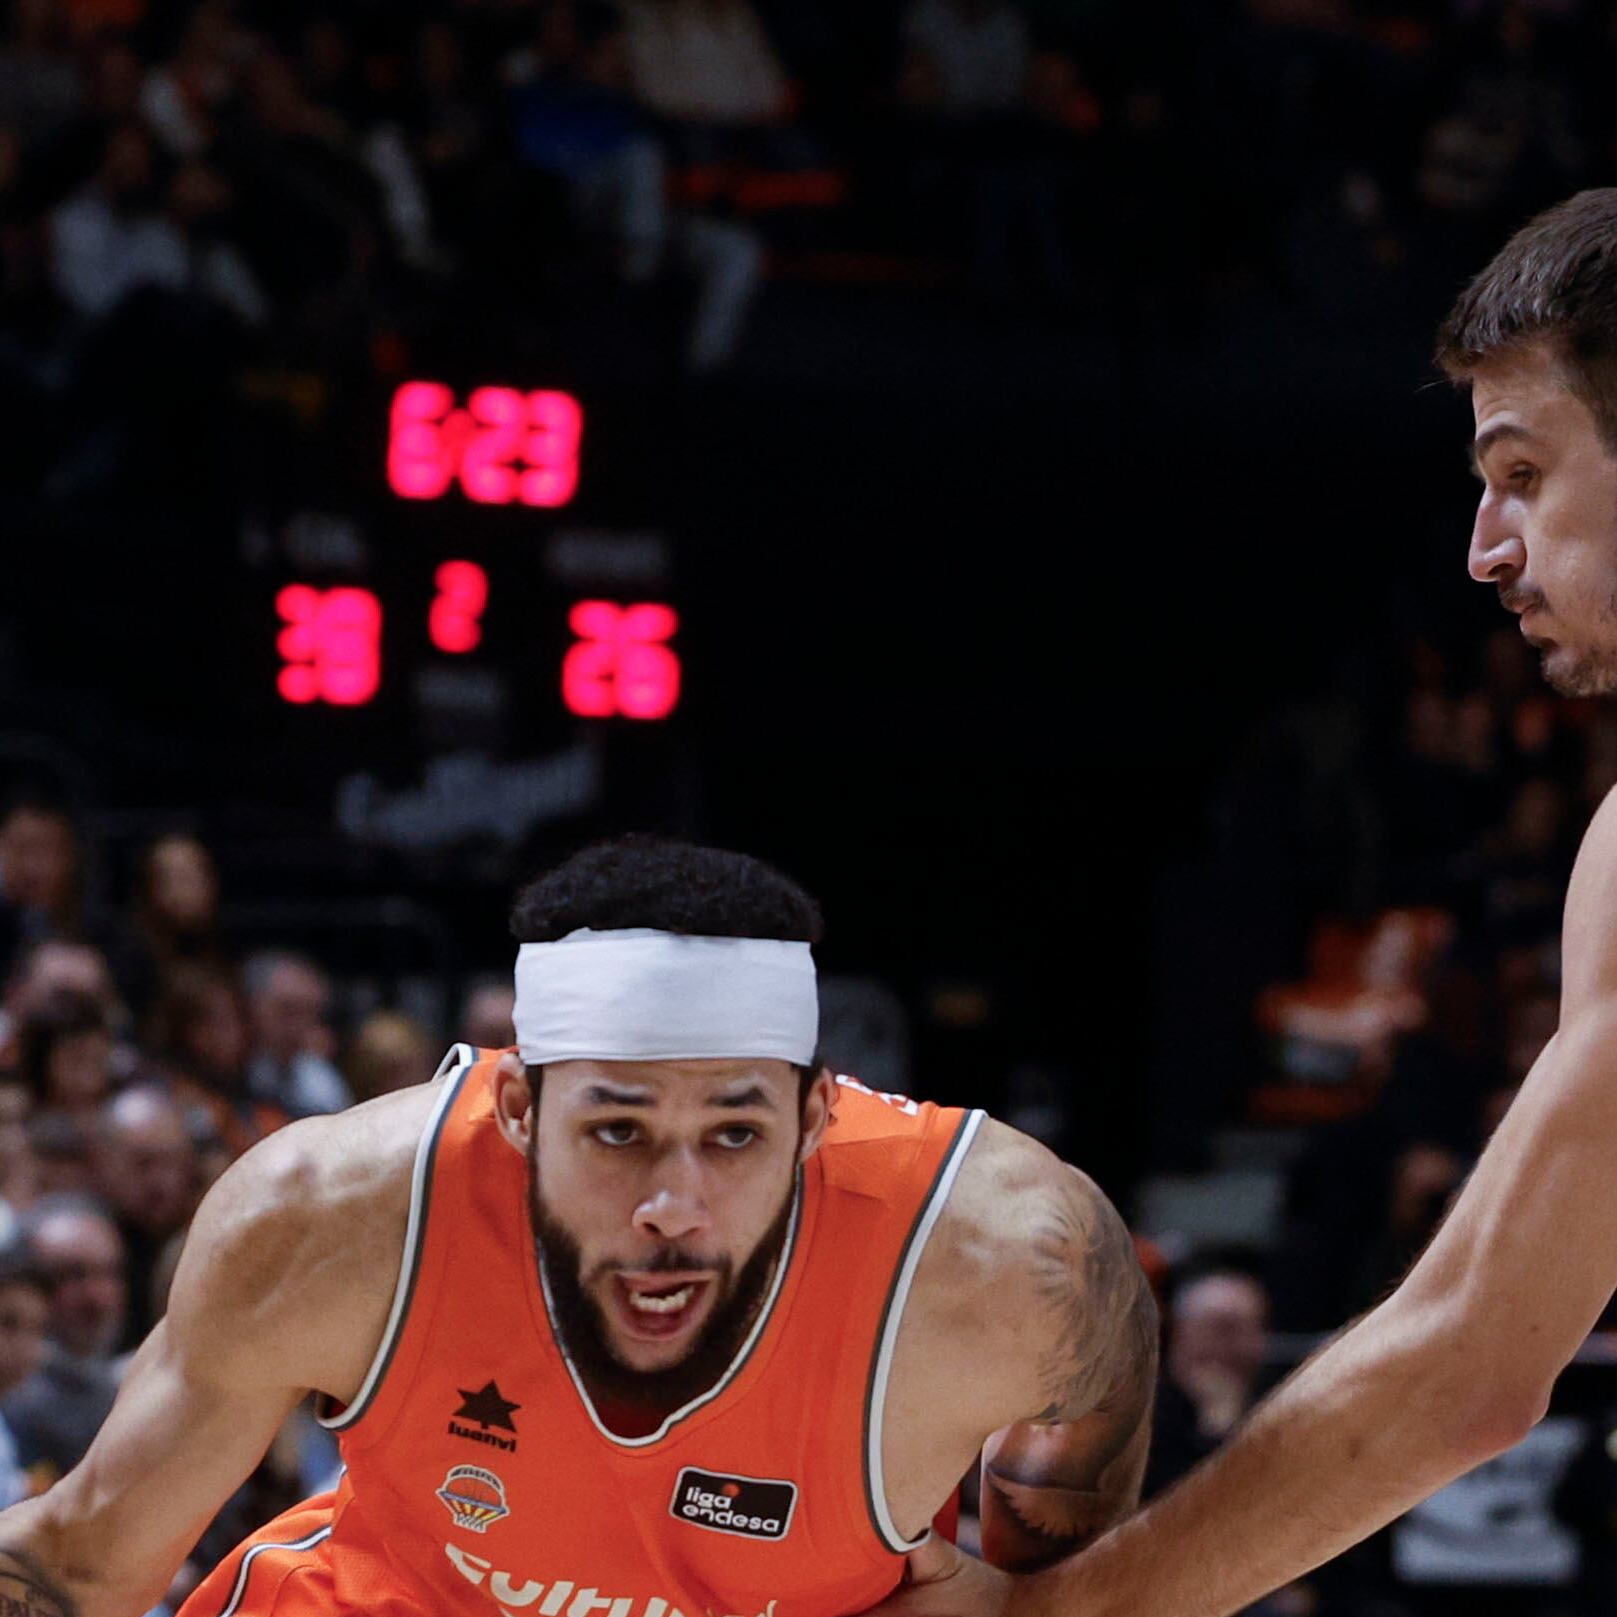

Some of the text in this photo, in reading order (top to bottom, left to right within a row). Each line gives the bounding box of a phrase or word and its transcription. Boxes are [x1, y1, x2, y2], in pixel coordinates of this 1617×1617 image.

[448, 1421, 516, 1453] luanvi
[686, 1487, 732, 1509] liga
[682, 1504, 780, 1532] endesa
